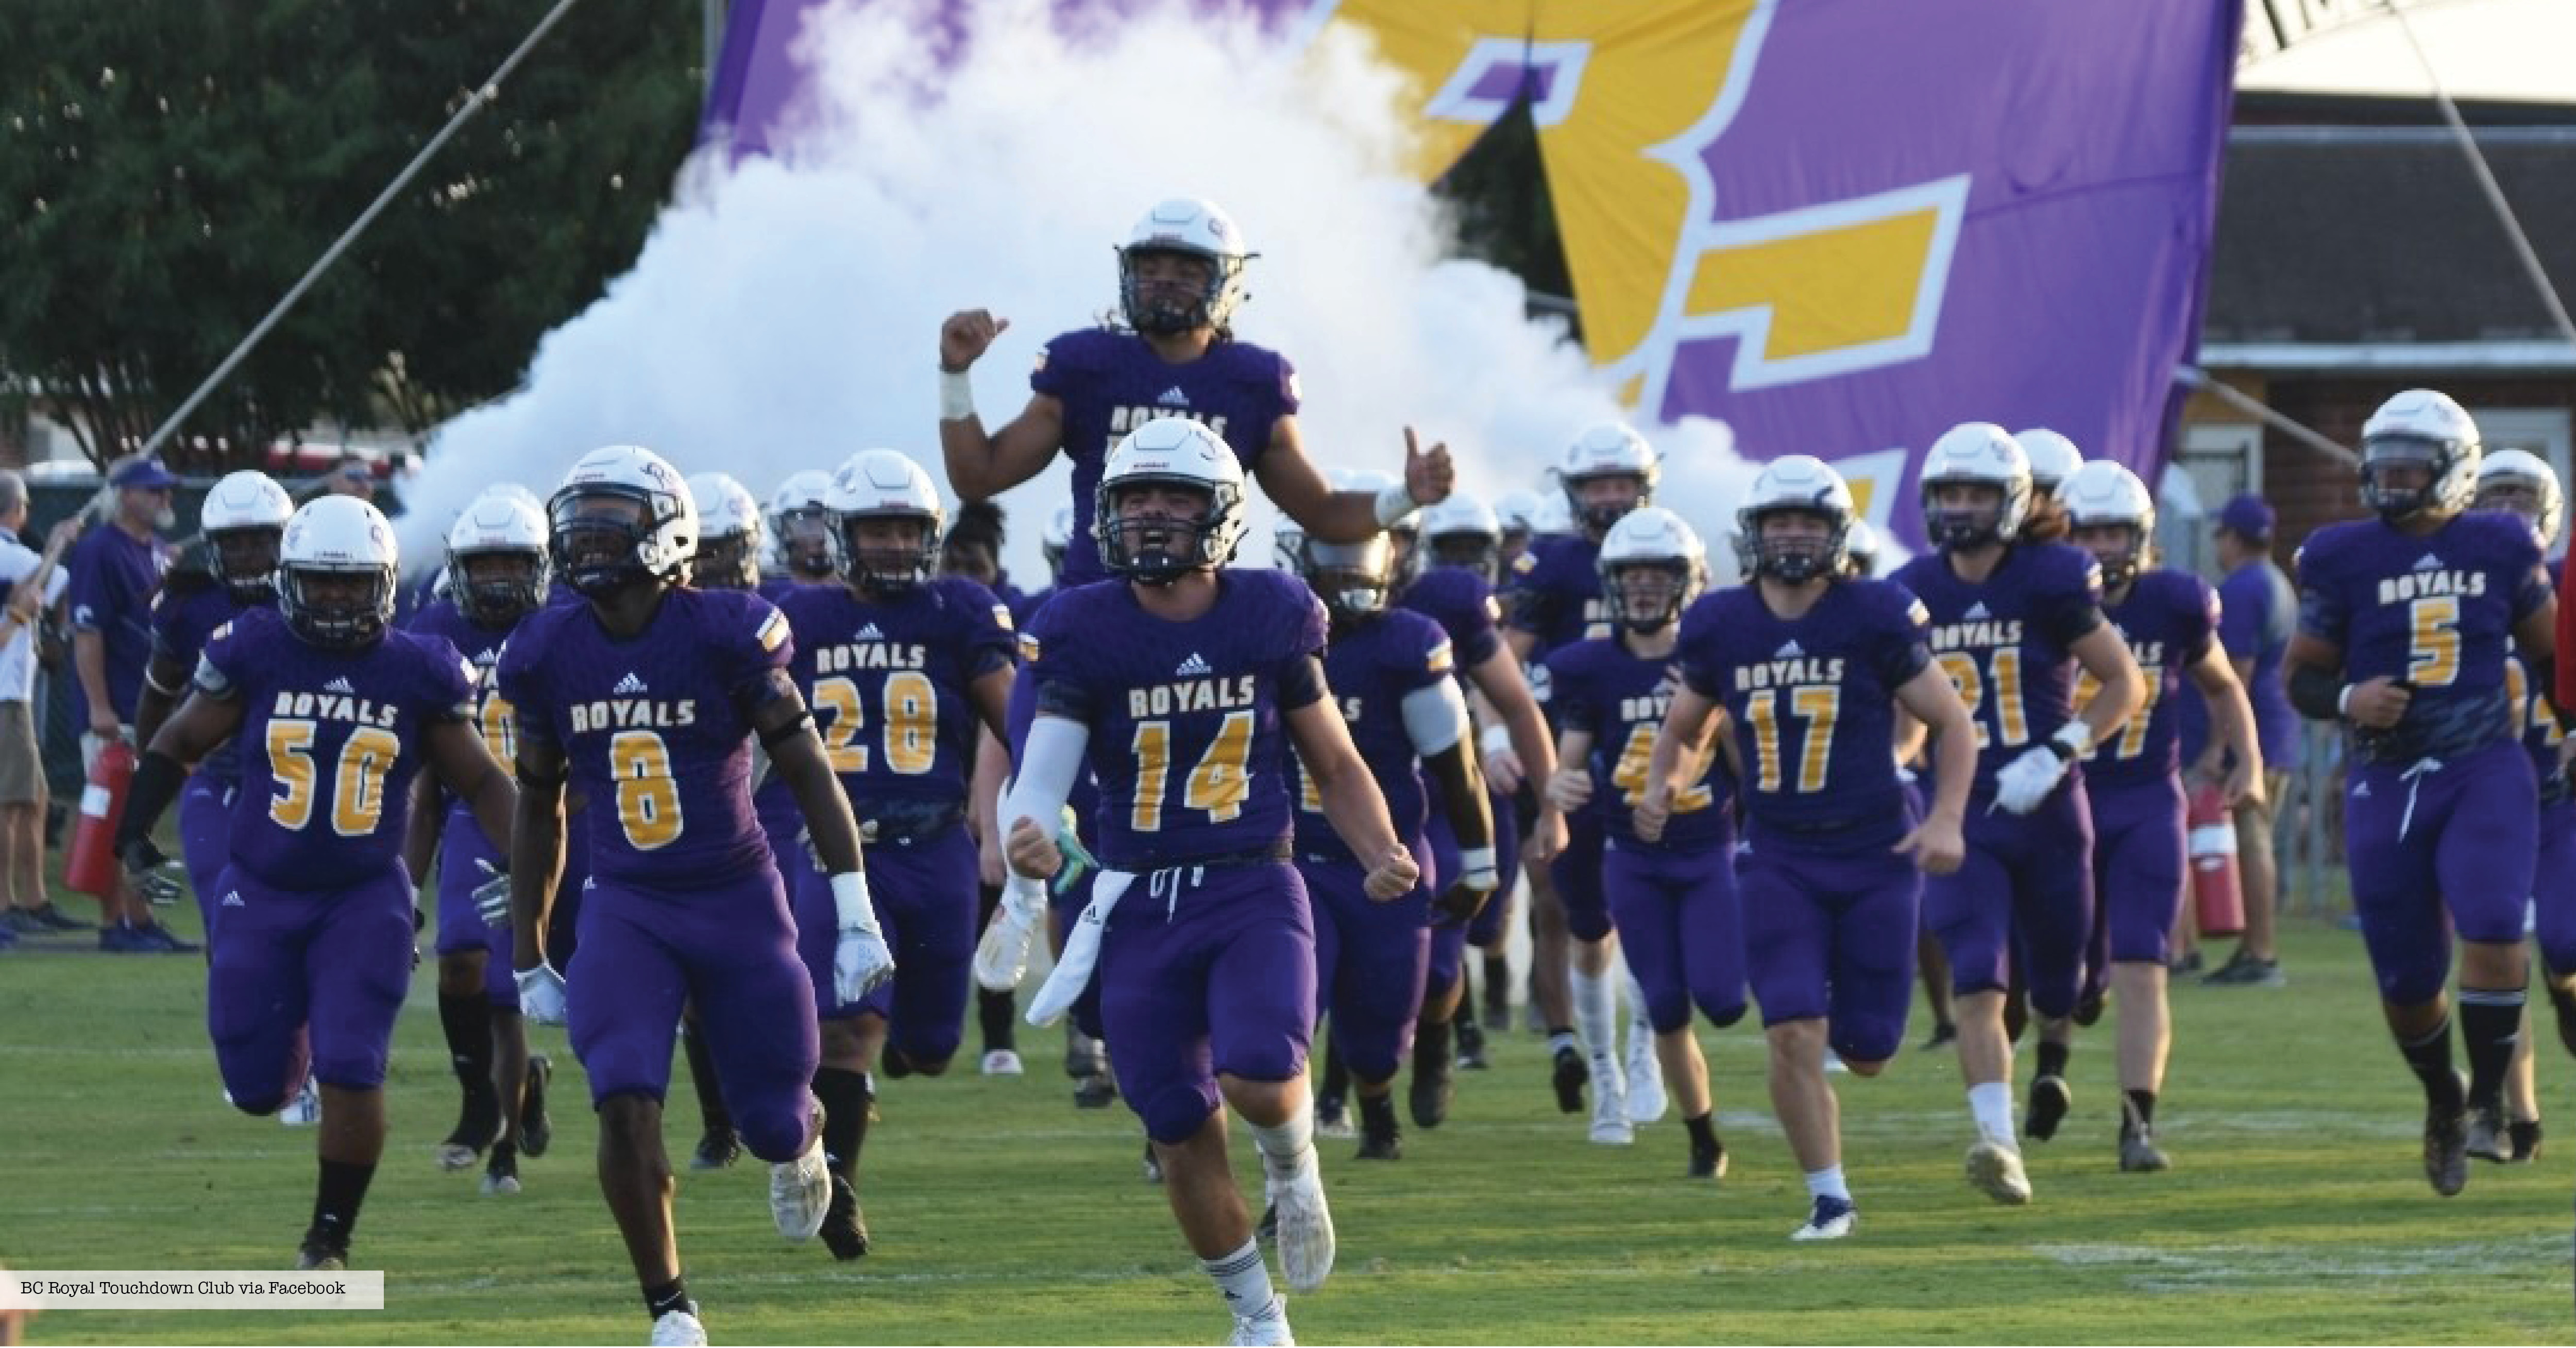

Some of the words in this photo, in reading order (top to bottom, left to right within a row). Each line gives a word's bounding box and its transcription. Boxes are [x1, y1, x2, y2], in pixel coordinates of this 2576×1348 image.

[2378, 570, 2486, 606] ROYALS
[816, 642, 926, 673] ROYALS
[1734, 657, 1845, 692] ROYALS
[2407, 596, 2462, 686] 5
[273, 691, 398, 727] ROYALS
[570, 699, 696, 733] ROYALS
[812, 670, 938, 775] 28
[1129, 675, 1254, 719] ROYALS
[1131, 709, 1255, 832] 14
[1744, 685, 1841, 793] 17
[266, 718, 400, 835] 50
[609, 730, 684, 850] 8
